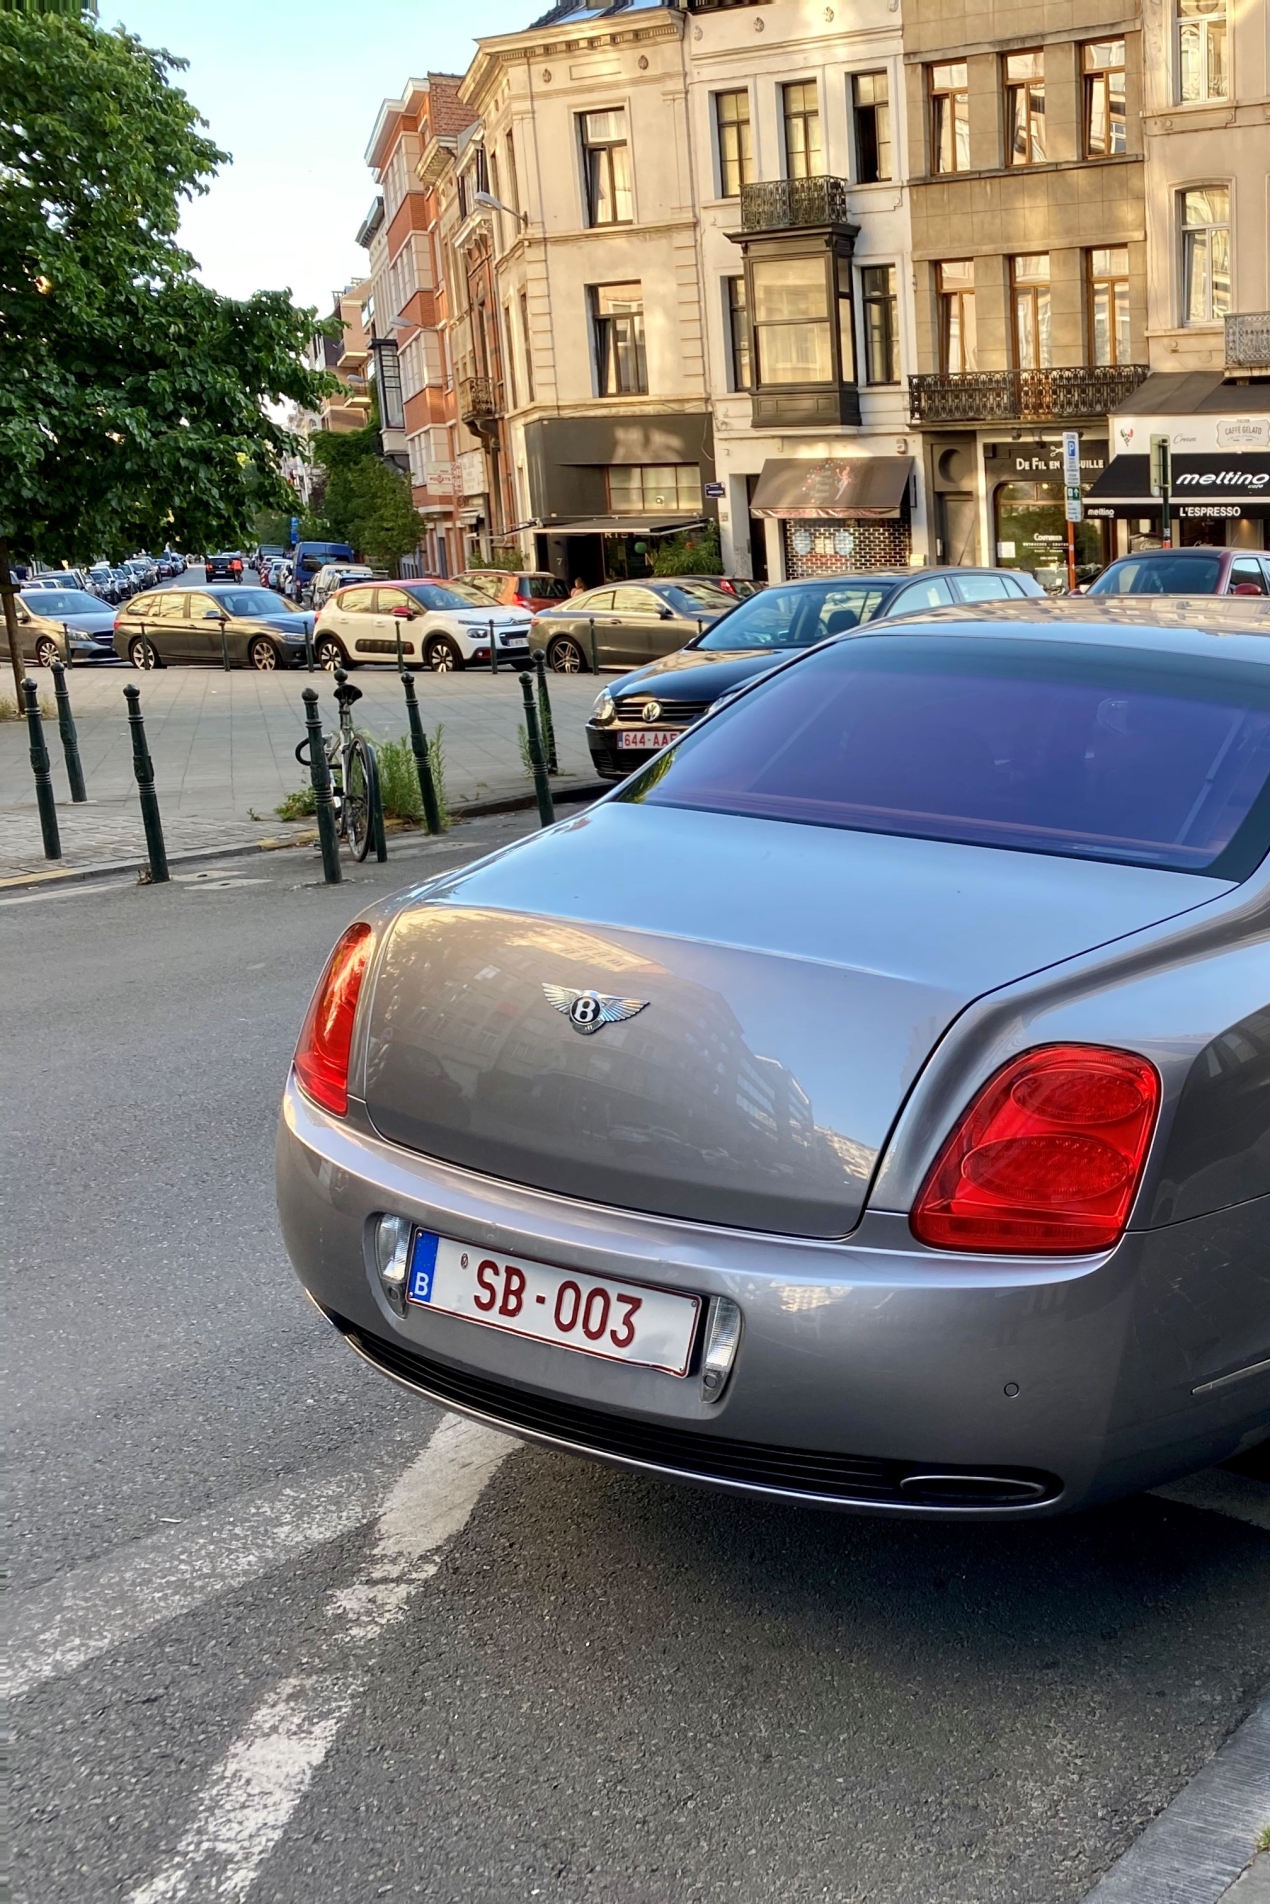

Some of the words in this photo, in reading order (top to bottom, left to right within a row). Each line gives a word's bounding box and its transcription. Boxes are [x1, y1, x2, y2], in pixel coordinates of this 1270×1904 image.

[1242, 426, 1262, 434] GELATO
[1174, 433, 1197, 445] Cream
[1032, 458, 1046, 470] FIL
[1050, 460, 1060, 469] EN
[1176, 471, 1270, 486] meltino
[1087, 508, 1115, 518] meltino
[1180, 506, 1242, 517] L'ESPRESSO
[556, 558, 562, 566] 7
[414, 1272, 430, 1297] B
[473, 1259, 643, 1348] SB-003
